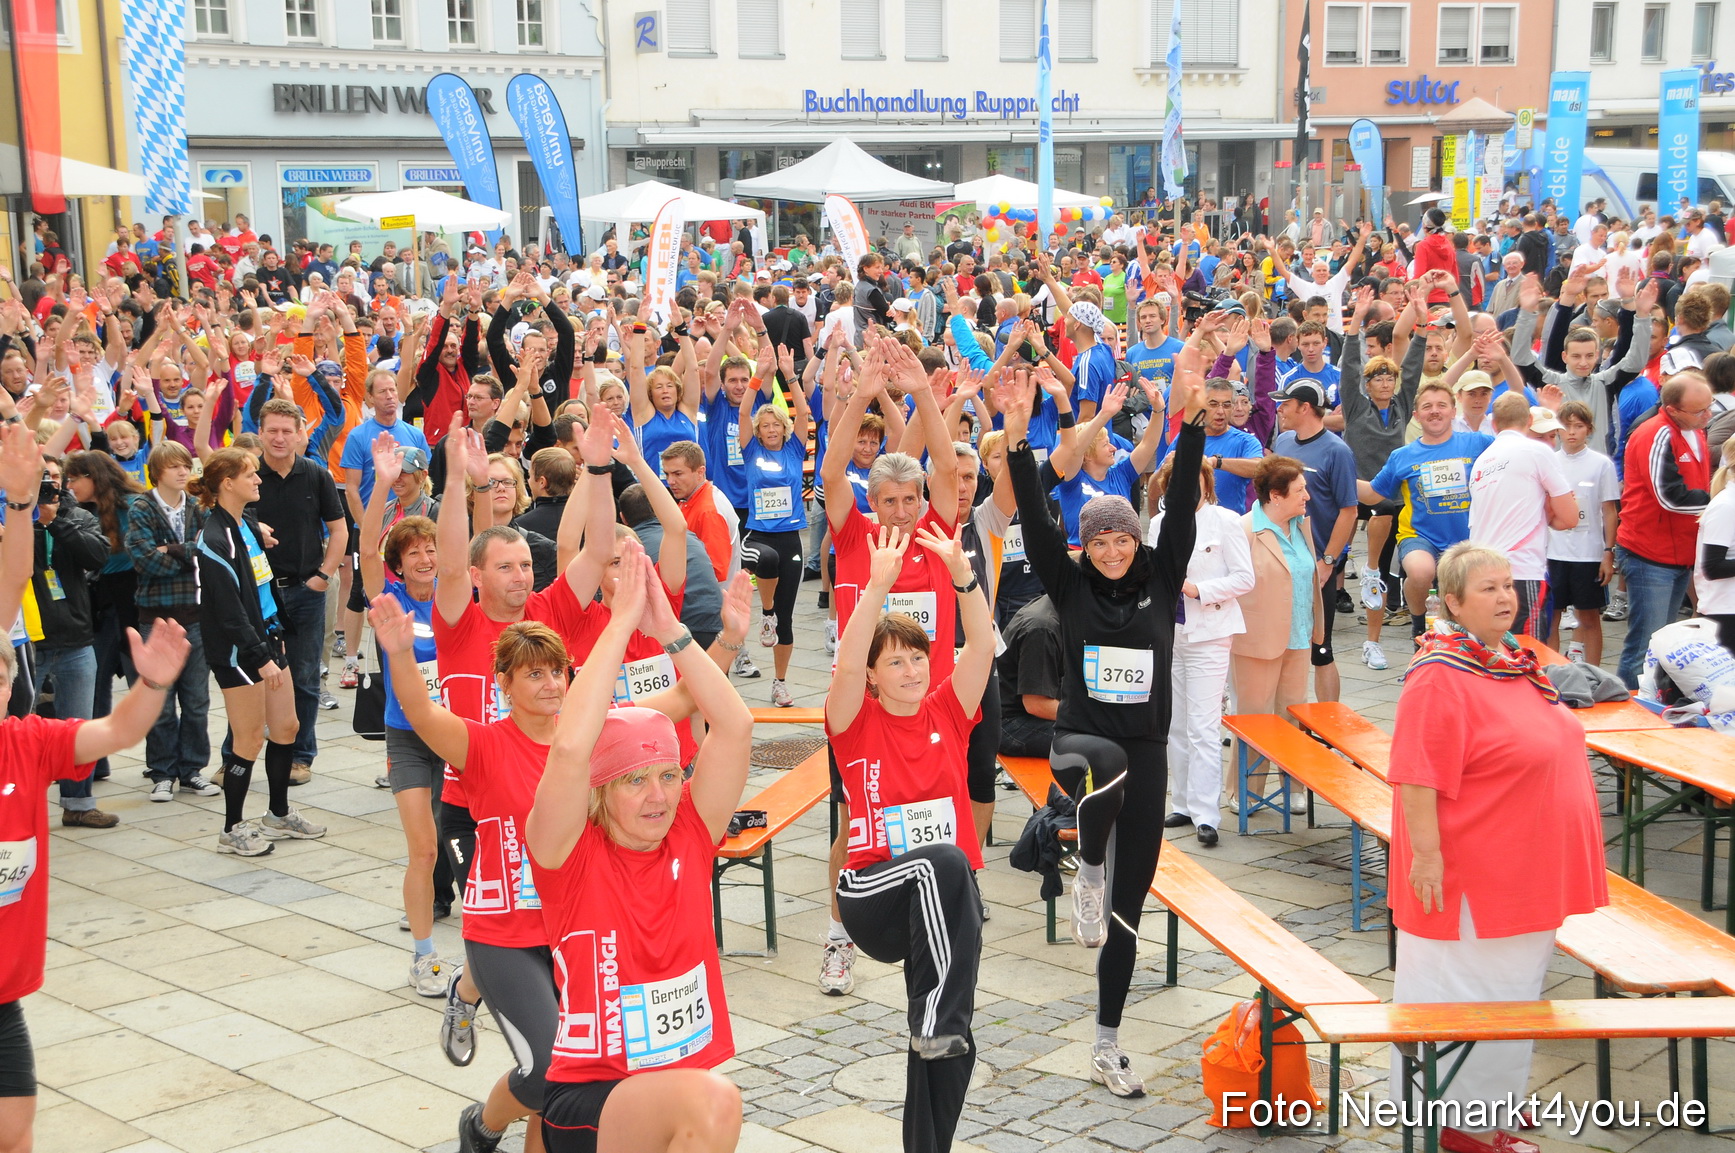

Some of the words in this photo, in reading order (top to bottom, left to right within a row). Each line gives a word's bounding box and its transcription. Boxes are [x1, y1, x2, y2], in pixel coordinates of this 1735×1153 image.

[272, 83, 389, 115] BRILLEN
[1552, 87, 1580, 102] maxi
[1666, 84, 1694, 101] maxi
[805, 88, 967, 119] Buchhandlung
[975, 89, 1080, 119] Rupprcht
[1568, 101, 1582, 112] dsl
[1684, 98, 1696, 109] dsl
[646, 157, 686, 170] Rupprecht
[288, 169, 329, 181] BRILLEN
[331, 169, 369, 181] WEBER
[410, 169, 448, 181] BRILLEN
[899, 200, 918, 208] Audi
[868, 208, 878, 216] Ihr
[881, 209, 907, 218] starker
[909, 211, 935, 220] Partne
[1432, 464, 1449, 473] Georg
[1434, 471, 1461, 484] 2942
[764, 498, 788, 509] 2234
[891, 597, 914, 606] Anton
[629, 663, 655, 677] Stefan
[1102, 667, 1145, 684] 3762
[633, 674, 670, 695] 3568
[867, 759, 881, 803] BÖGL
[906, 807, 933, 821] Sonja
[872, 807, 887, 848] MAX
[911, 821, 952, 844] 3514
[503, 815, 521, 863] BÖGL
[598, 929, 621, 991] BÖGL
[651, 979, 699, 1005] Gertraud
[656, 996, 705, 1035] 3515
[604, 996, 623, 1057] MAX
